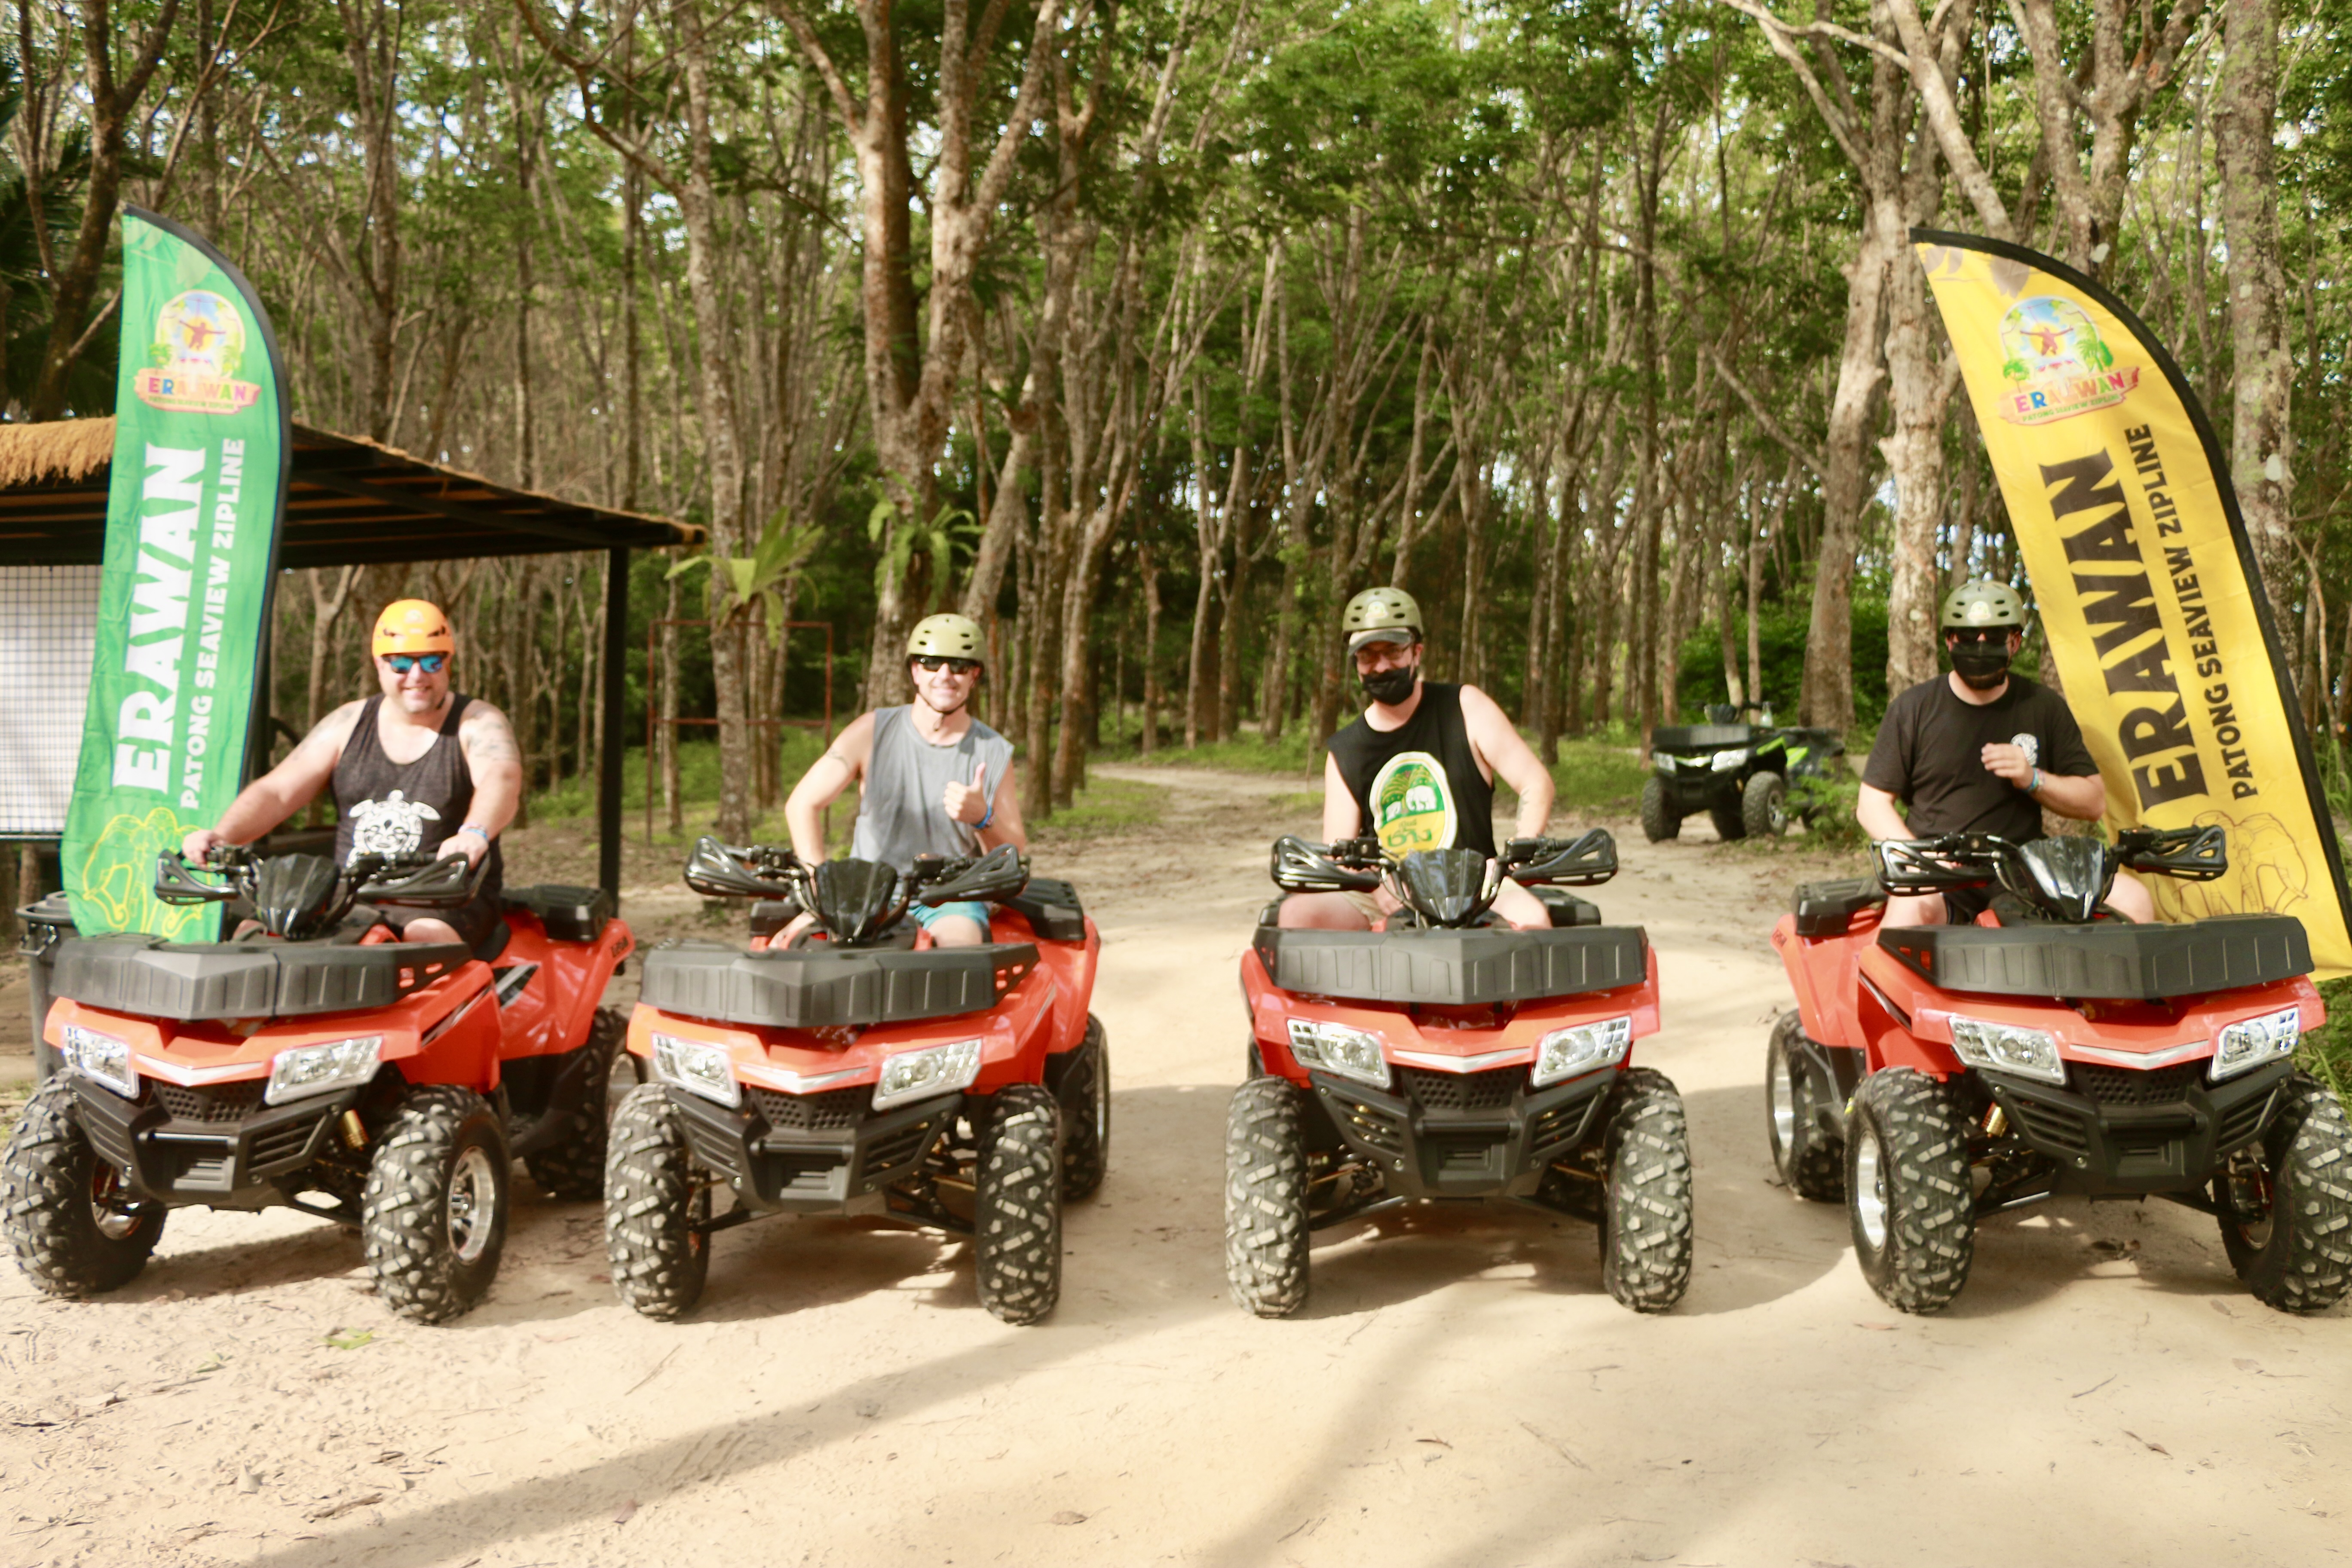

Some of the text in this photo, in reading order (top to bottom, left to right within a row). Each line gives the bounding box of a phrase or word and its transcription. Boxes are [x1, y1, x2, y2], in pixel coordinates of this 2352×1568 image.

[111, 441, 207, 795] ERAWAN
[179, 438, 245, 810] PATONG SEAVIEW ZIPLINE
[2038, 447, 2209, 812] ERAWAN
[2124, 423, 2257, 800] PATONG SEAVIEW ZIPLINE
